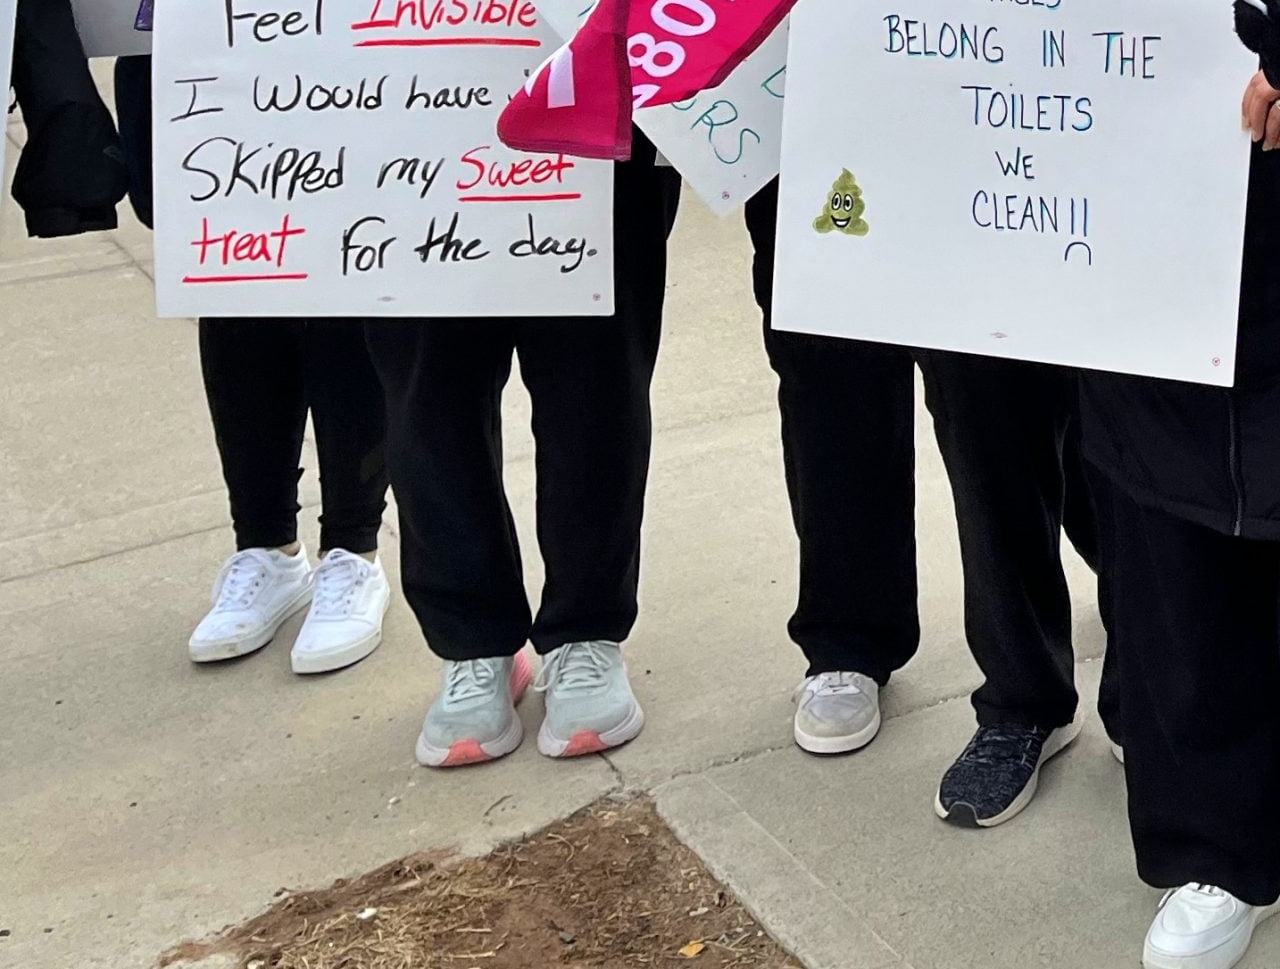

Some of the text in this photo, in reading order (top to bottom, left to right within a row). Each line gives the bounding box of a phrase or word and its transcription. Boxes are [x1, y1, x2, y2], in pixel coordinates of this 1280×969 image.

[884, 14, 1162, 80] BELONG IN THE
[170, 76, 224, 123] I
[405, 75, 493, 109] have
[376, 156, 445, 200] my
[995, 151, 1035, 179] WE
[190, 213, 306, 268] treat
[414, 211, 491, 264] the
